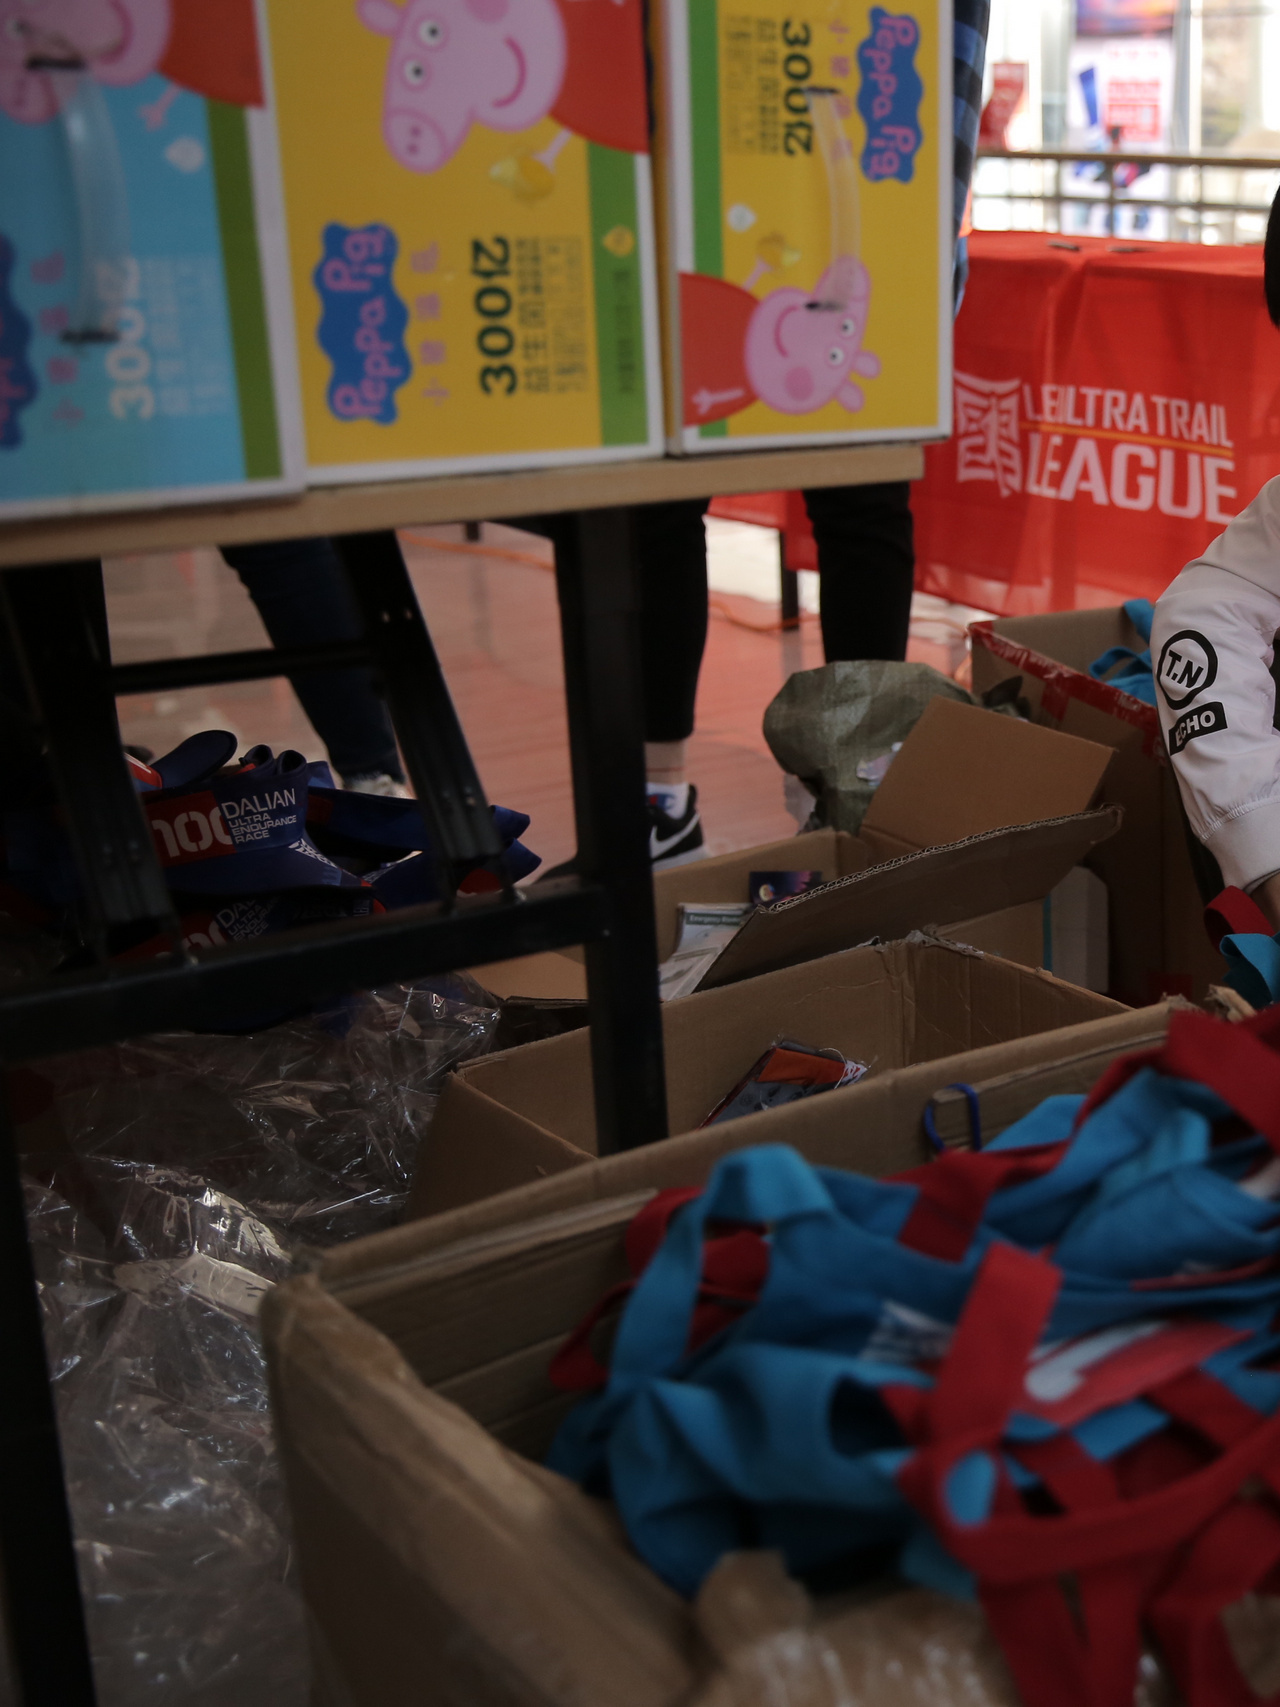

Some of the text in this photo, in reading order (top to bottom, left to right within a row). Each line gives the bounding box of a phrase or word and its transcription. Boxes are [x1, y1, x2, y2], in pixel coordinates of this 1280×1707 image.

[863, 17, 916, 181] Peppa Pig
[322, 227, 404, 417] Peppa Pig
[471, 235, 517, 396] 300亿
[1150, 394, 1234, 449] TRAIL
[1025, 432, 1238, 527] LEAGUE
[1165, 649, 1204, 689] T.N
[1175, 709, 1217, 748] ECHO
[221, 787, 297, 820] DALIAN
[228, 812, 272, 829] ULTRA
[231, 814, 298, 837] ENDURANCE
[234, 829, 271, 845] RACE
